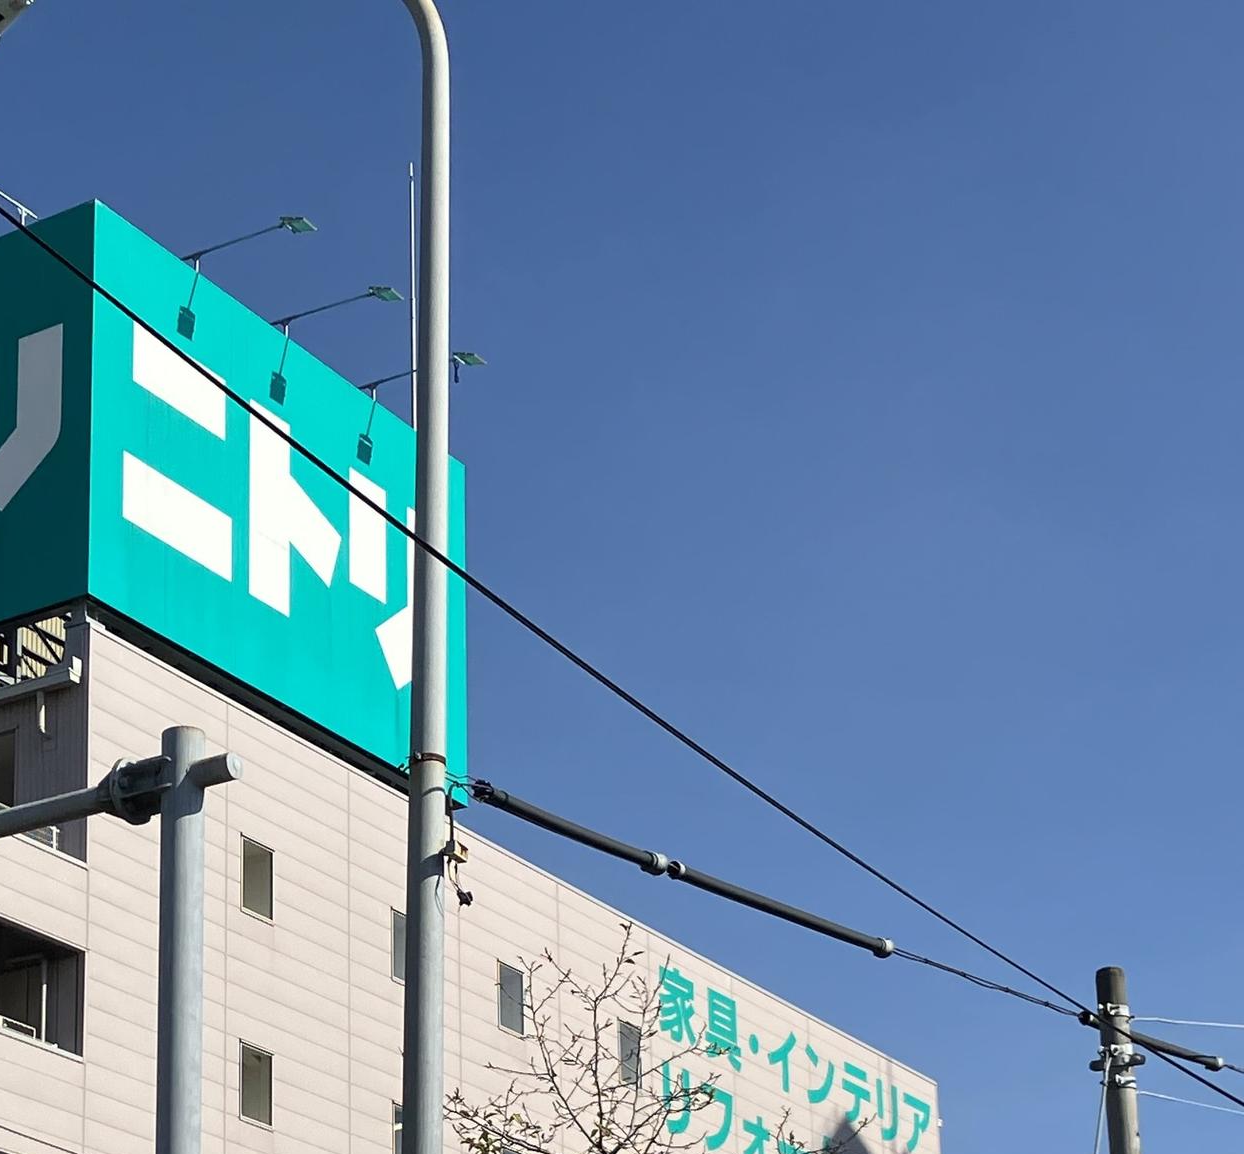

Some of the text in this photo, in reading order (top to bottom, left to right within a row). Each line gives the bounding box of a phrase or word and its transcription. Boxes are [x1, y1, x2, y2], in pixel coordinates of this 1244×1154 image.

[122, 320, 415, 690] ニトリ
[659, 965, 930, 1153] 家具・インテリア
